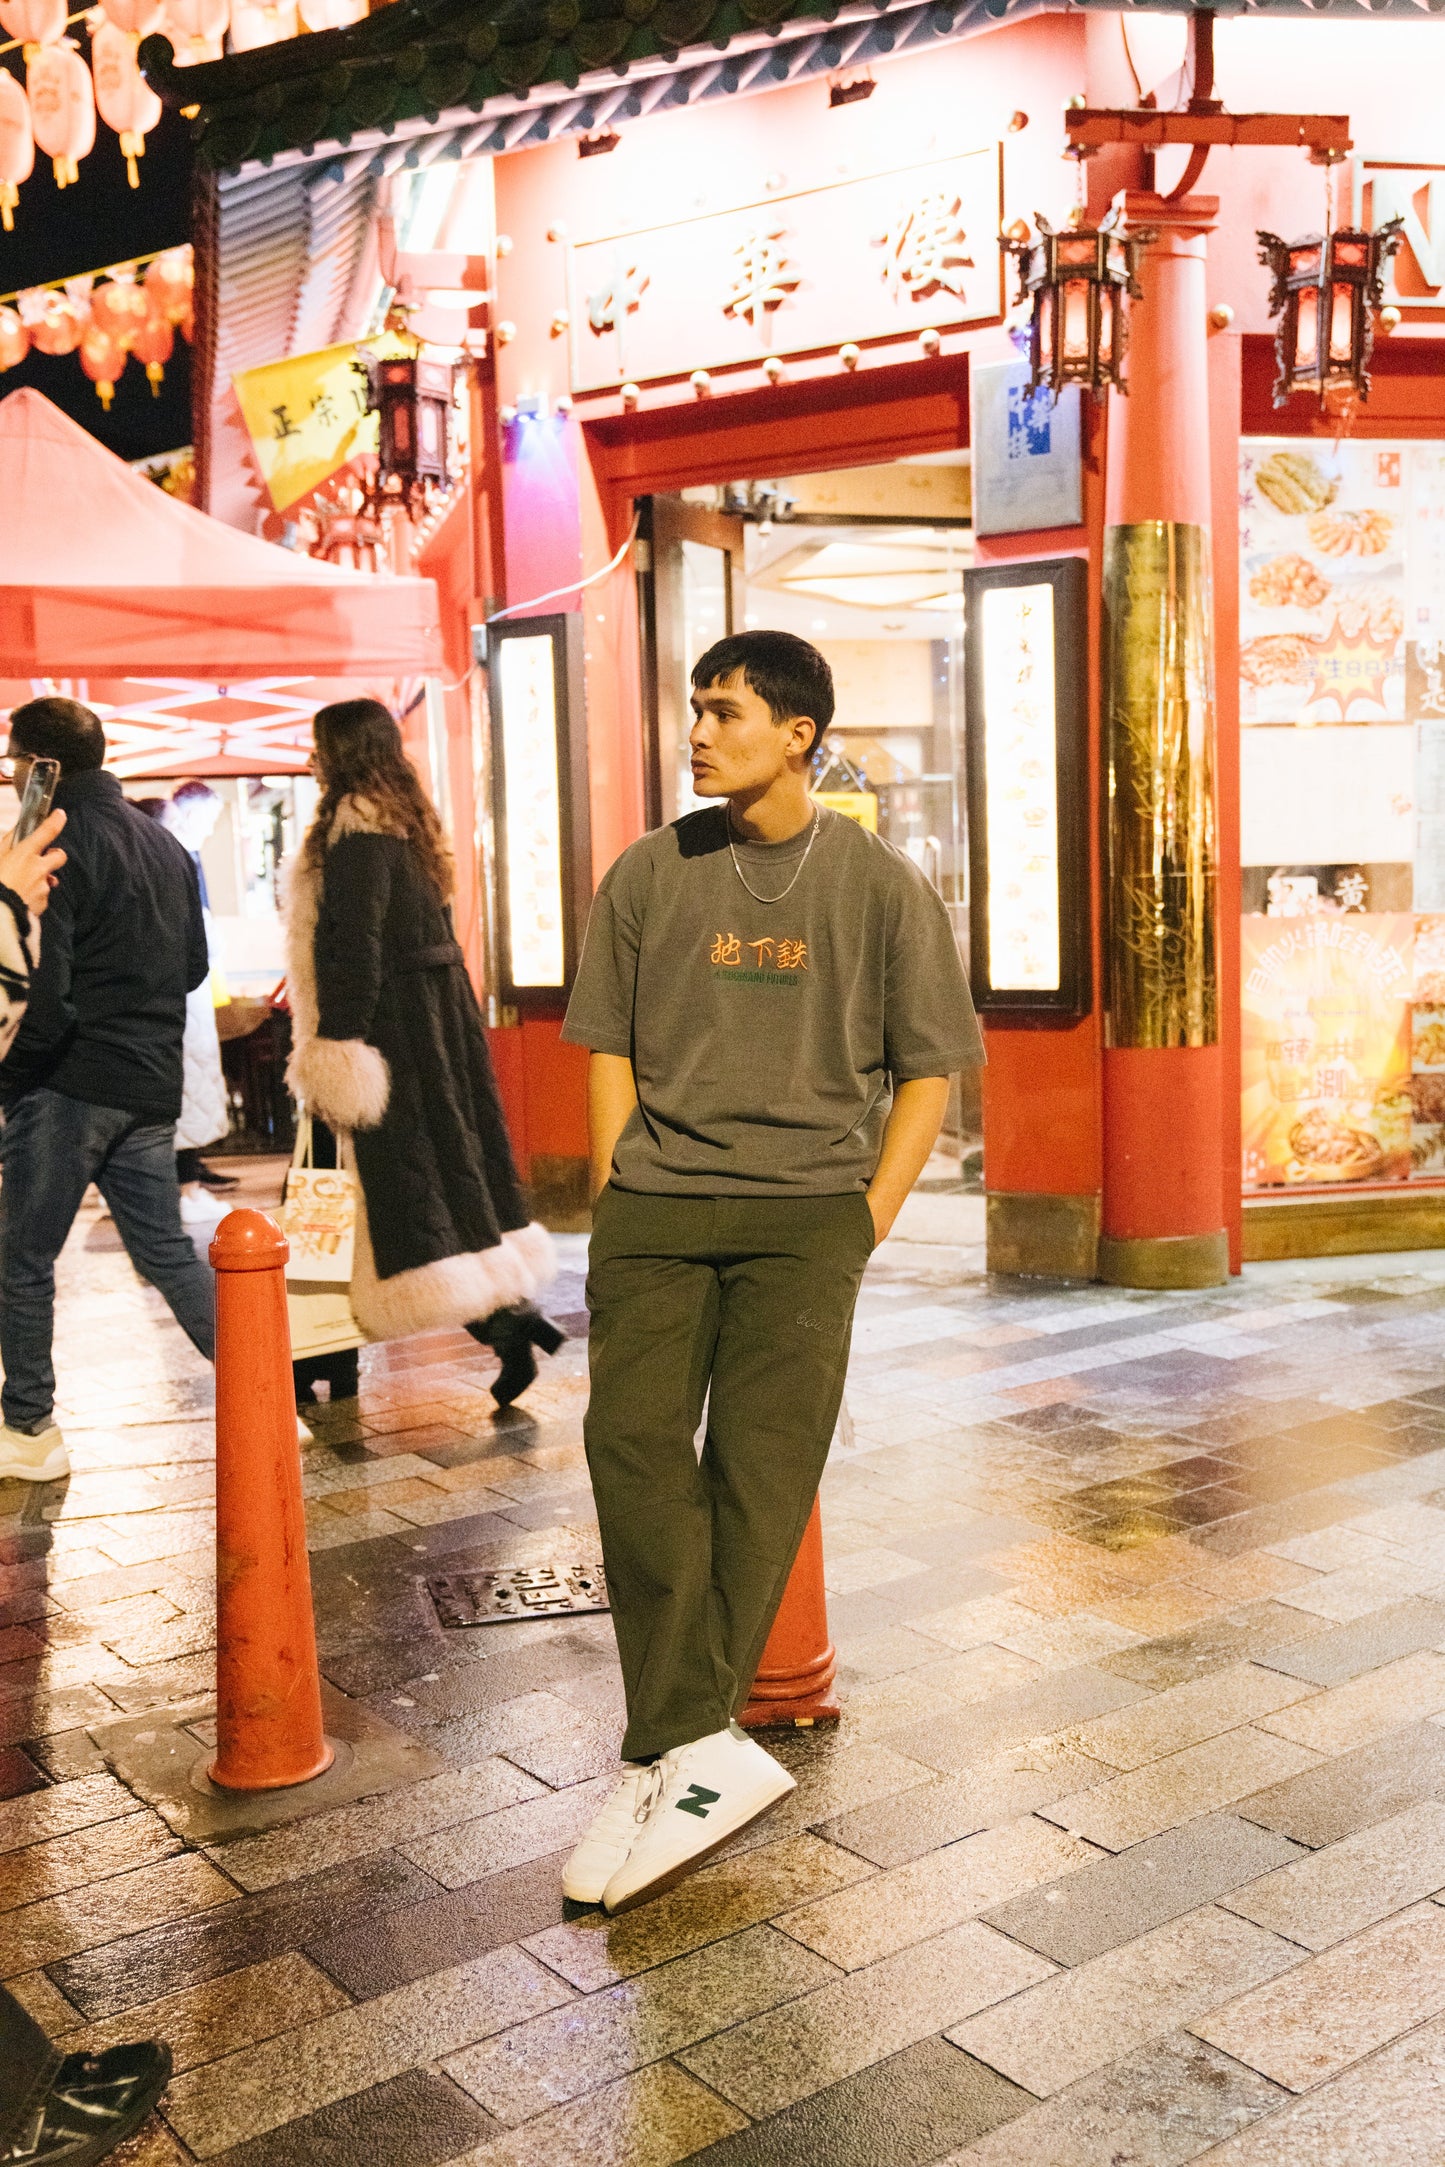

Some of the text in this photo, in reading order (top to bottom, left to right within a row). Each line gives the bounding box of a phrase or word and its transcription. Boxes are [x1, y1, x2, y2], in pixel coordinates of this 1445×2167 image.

[710, 933, 808, 970] 地下鉄
[675, 1783, 721, 1819] N
